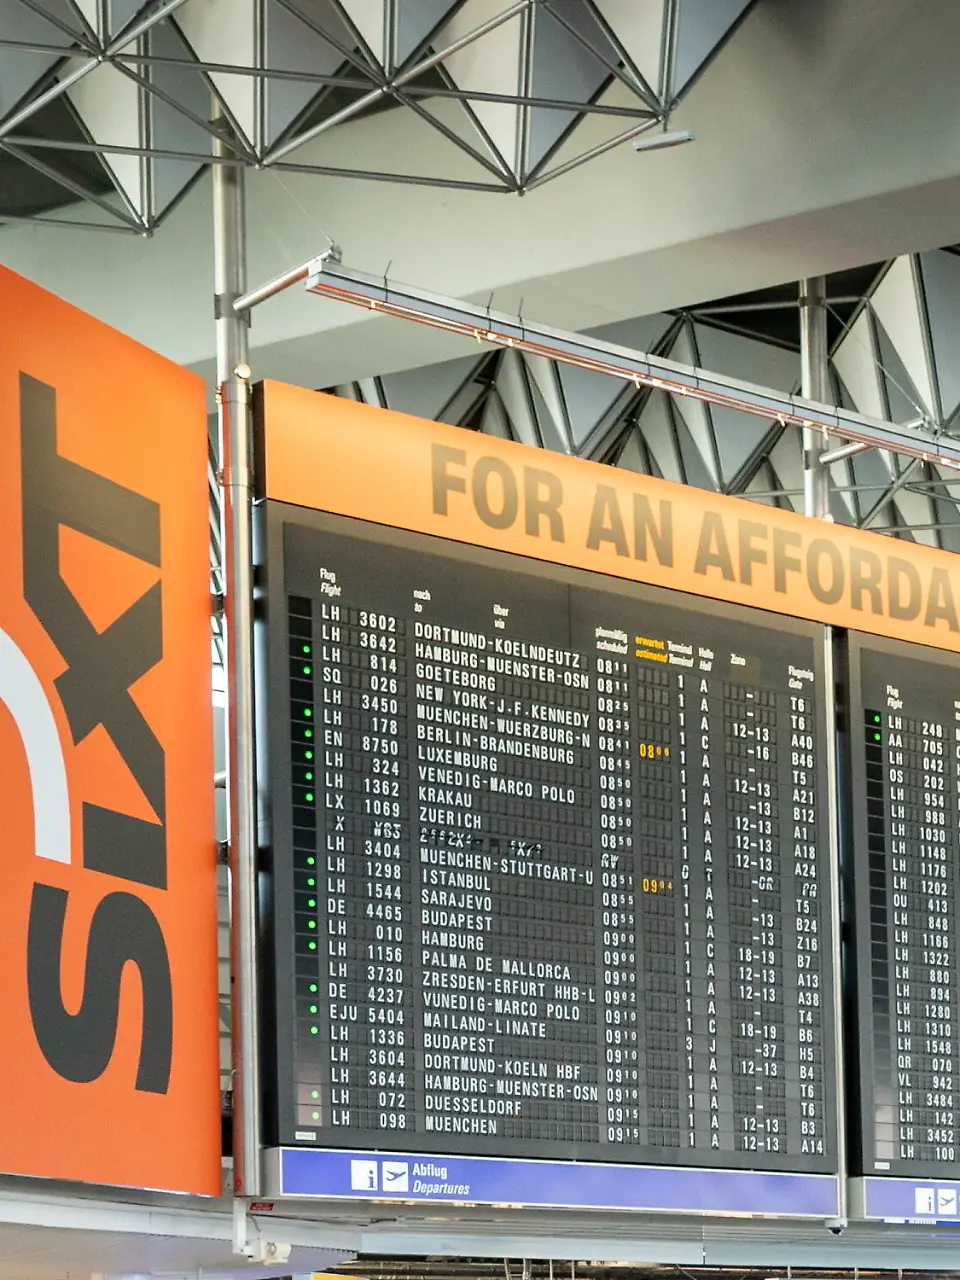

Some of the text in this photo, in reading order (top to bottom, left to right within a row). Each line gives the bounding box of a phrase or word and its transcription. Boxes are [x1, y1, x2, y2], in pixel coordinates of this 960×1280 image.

[431, 442, 564, 546] FOR
[586, 484, 674, 568] AN
[320, 568, 336, 583] Flug
[320, 582, 341, 597] Flight
[414, 602, 423, 613] to
[360, 610, 396, 633] 3602
[414, 621, 579, 668] DORTMUND-KOELNDEUTZ
[360, 631, 588, 689] 3642 HAMBURG-MUENSTER-OSN
[370, 654, 812, 750] 814 GOETEBORG A40
[19, 370, 173, 1095] SIXT
[362, 694, 589, 748] 3450 MUENCHEN-WUERZBURG-N
[370, 674, 813, 768] 026 NEW YORK-J.F.KENNEDY B46
[362, 735, 496, 772] 8750 LUXEMBURG
[371, 716, 573, 765] 178 BERLIN-BRANDENBURG
[372, 757, 574, 804] 324 VENEDIG-MARCO POLO
[363, 777, 815, 860] 1362 KRAKAU A18
[364, 798, 480, 830] 1069 ZUERICH
[365, 839, 401, 860] 3404
[419, 847, 592, 885] MUENCHEN-STUTTGART-U
[365, 860, 490, 892] 1298 ISTANBUL
[366, 881, 491, 912] 1544 SARAJEVO
[366, 902, 491, 932] 4465 BUDAPEST
[367, 944, 570, 980] 1156 PALMA DE MALLORCA
[376, 924, 818, 988] 010 HAMBURG A13
[367, 964, 595, 1003] 3730 ZRESDEN-ERFURT HHB-L
[368, 985, 579, 1021] 4237 VUNEDIG-MARCO POLO
[368, 1006, 545, 1037] 5404 MAILAND-LINATE
[369, 1027, 494, 1053] 1336 BUDAPEST
[369, 1048, 580, 1080] 3604 DORTMUND-KOELN HBF
[370, 1069, 597, 1101] 3644 HAMBURG-MUENSTER-OSN
[379, 1090, 521, 1115] 072 DUESSELDORF
[380, 1111, 496, 1134] 098 MUENCHEN
[412, 1162, 448, 1179] Abflug
[412, 1180, 470, 1196] Departures
